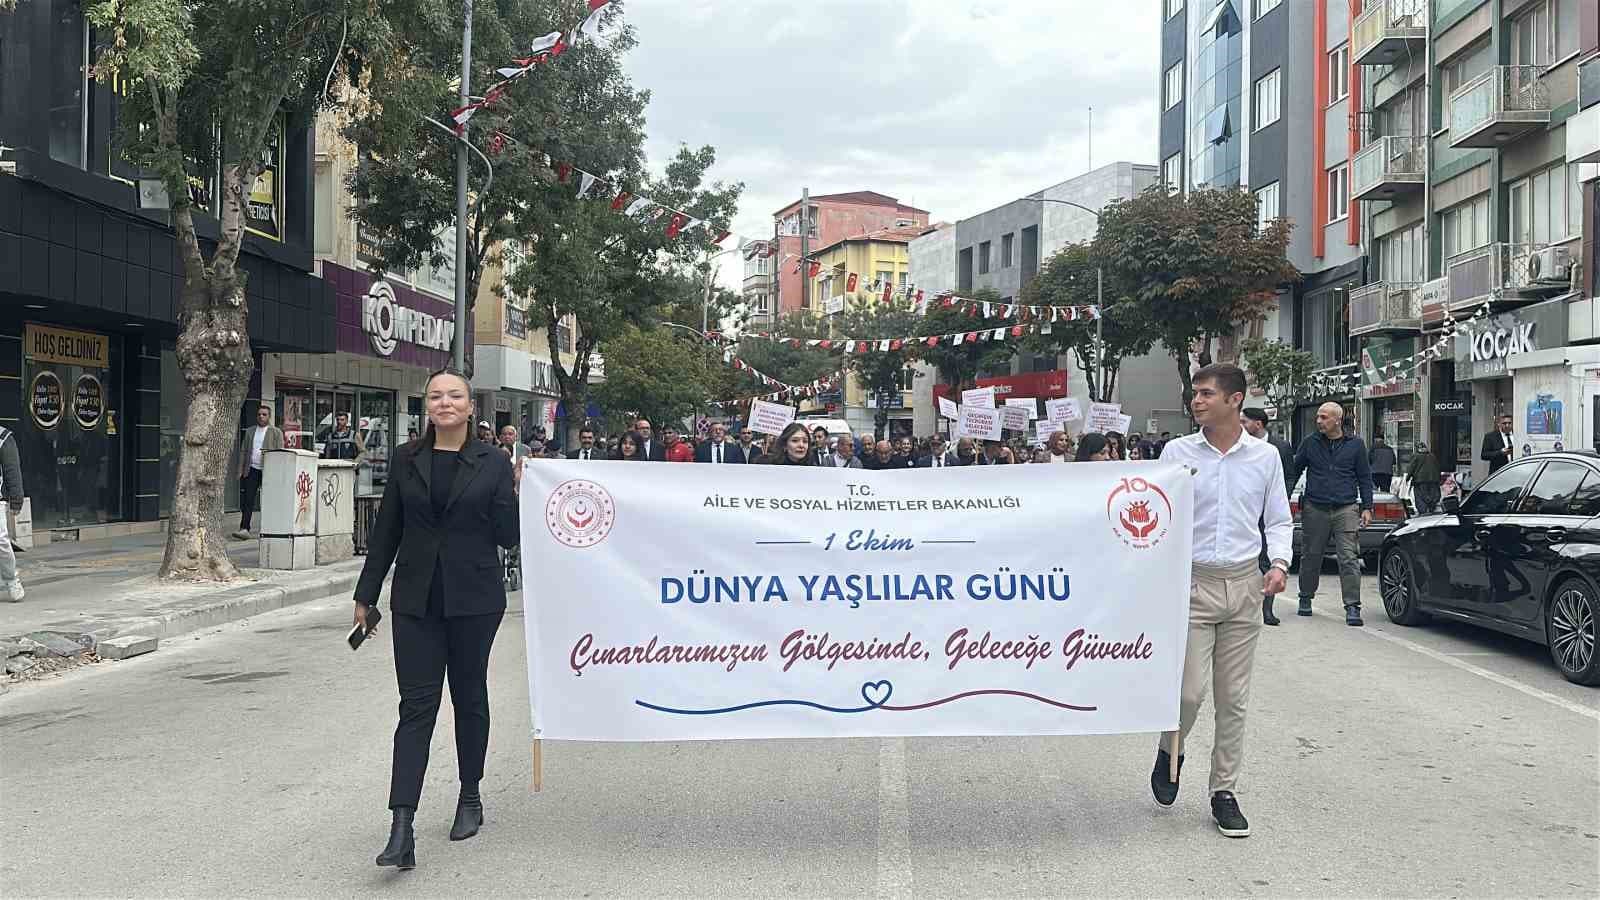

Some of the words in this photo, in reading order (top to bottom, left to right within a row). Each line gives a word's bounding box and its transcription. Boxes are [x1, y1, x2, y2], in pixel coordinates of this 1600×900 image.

[34, 332, 56, 359] HOŞ
[58, 335, 102, 361] GELDİNİZ
[847, 484, 874, 496] T.C.
[703, 494, 740, 508] AİLE
[744, 498, 765, 509] VE
[769, 498, 832, 512] SOSYAL
[837, 494, 928, 511] HİZMETLER
[932, 495, 1021, 511] BAKANLIĞI
[824, 532, 837, 551] 1
[845, 529, 915, 551] Ekim
[661, 569, 789, 604] DÜNYA
[798, 574, 955, 608] YAŞLILAR
[967, 567, 1070, 601] GÜNÜ
[570, 633, 768, 677] Çınarlarımızın
[780, 629, 930, 672] Gölgesinde,
[945, 627, 1052, 671] Geleceğe
[1063, 628, 1153, 671] Güvenle
